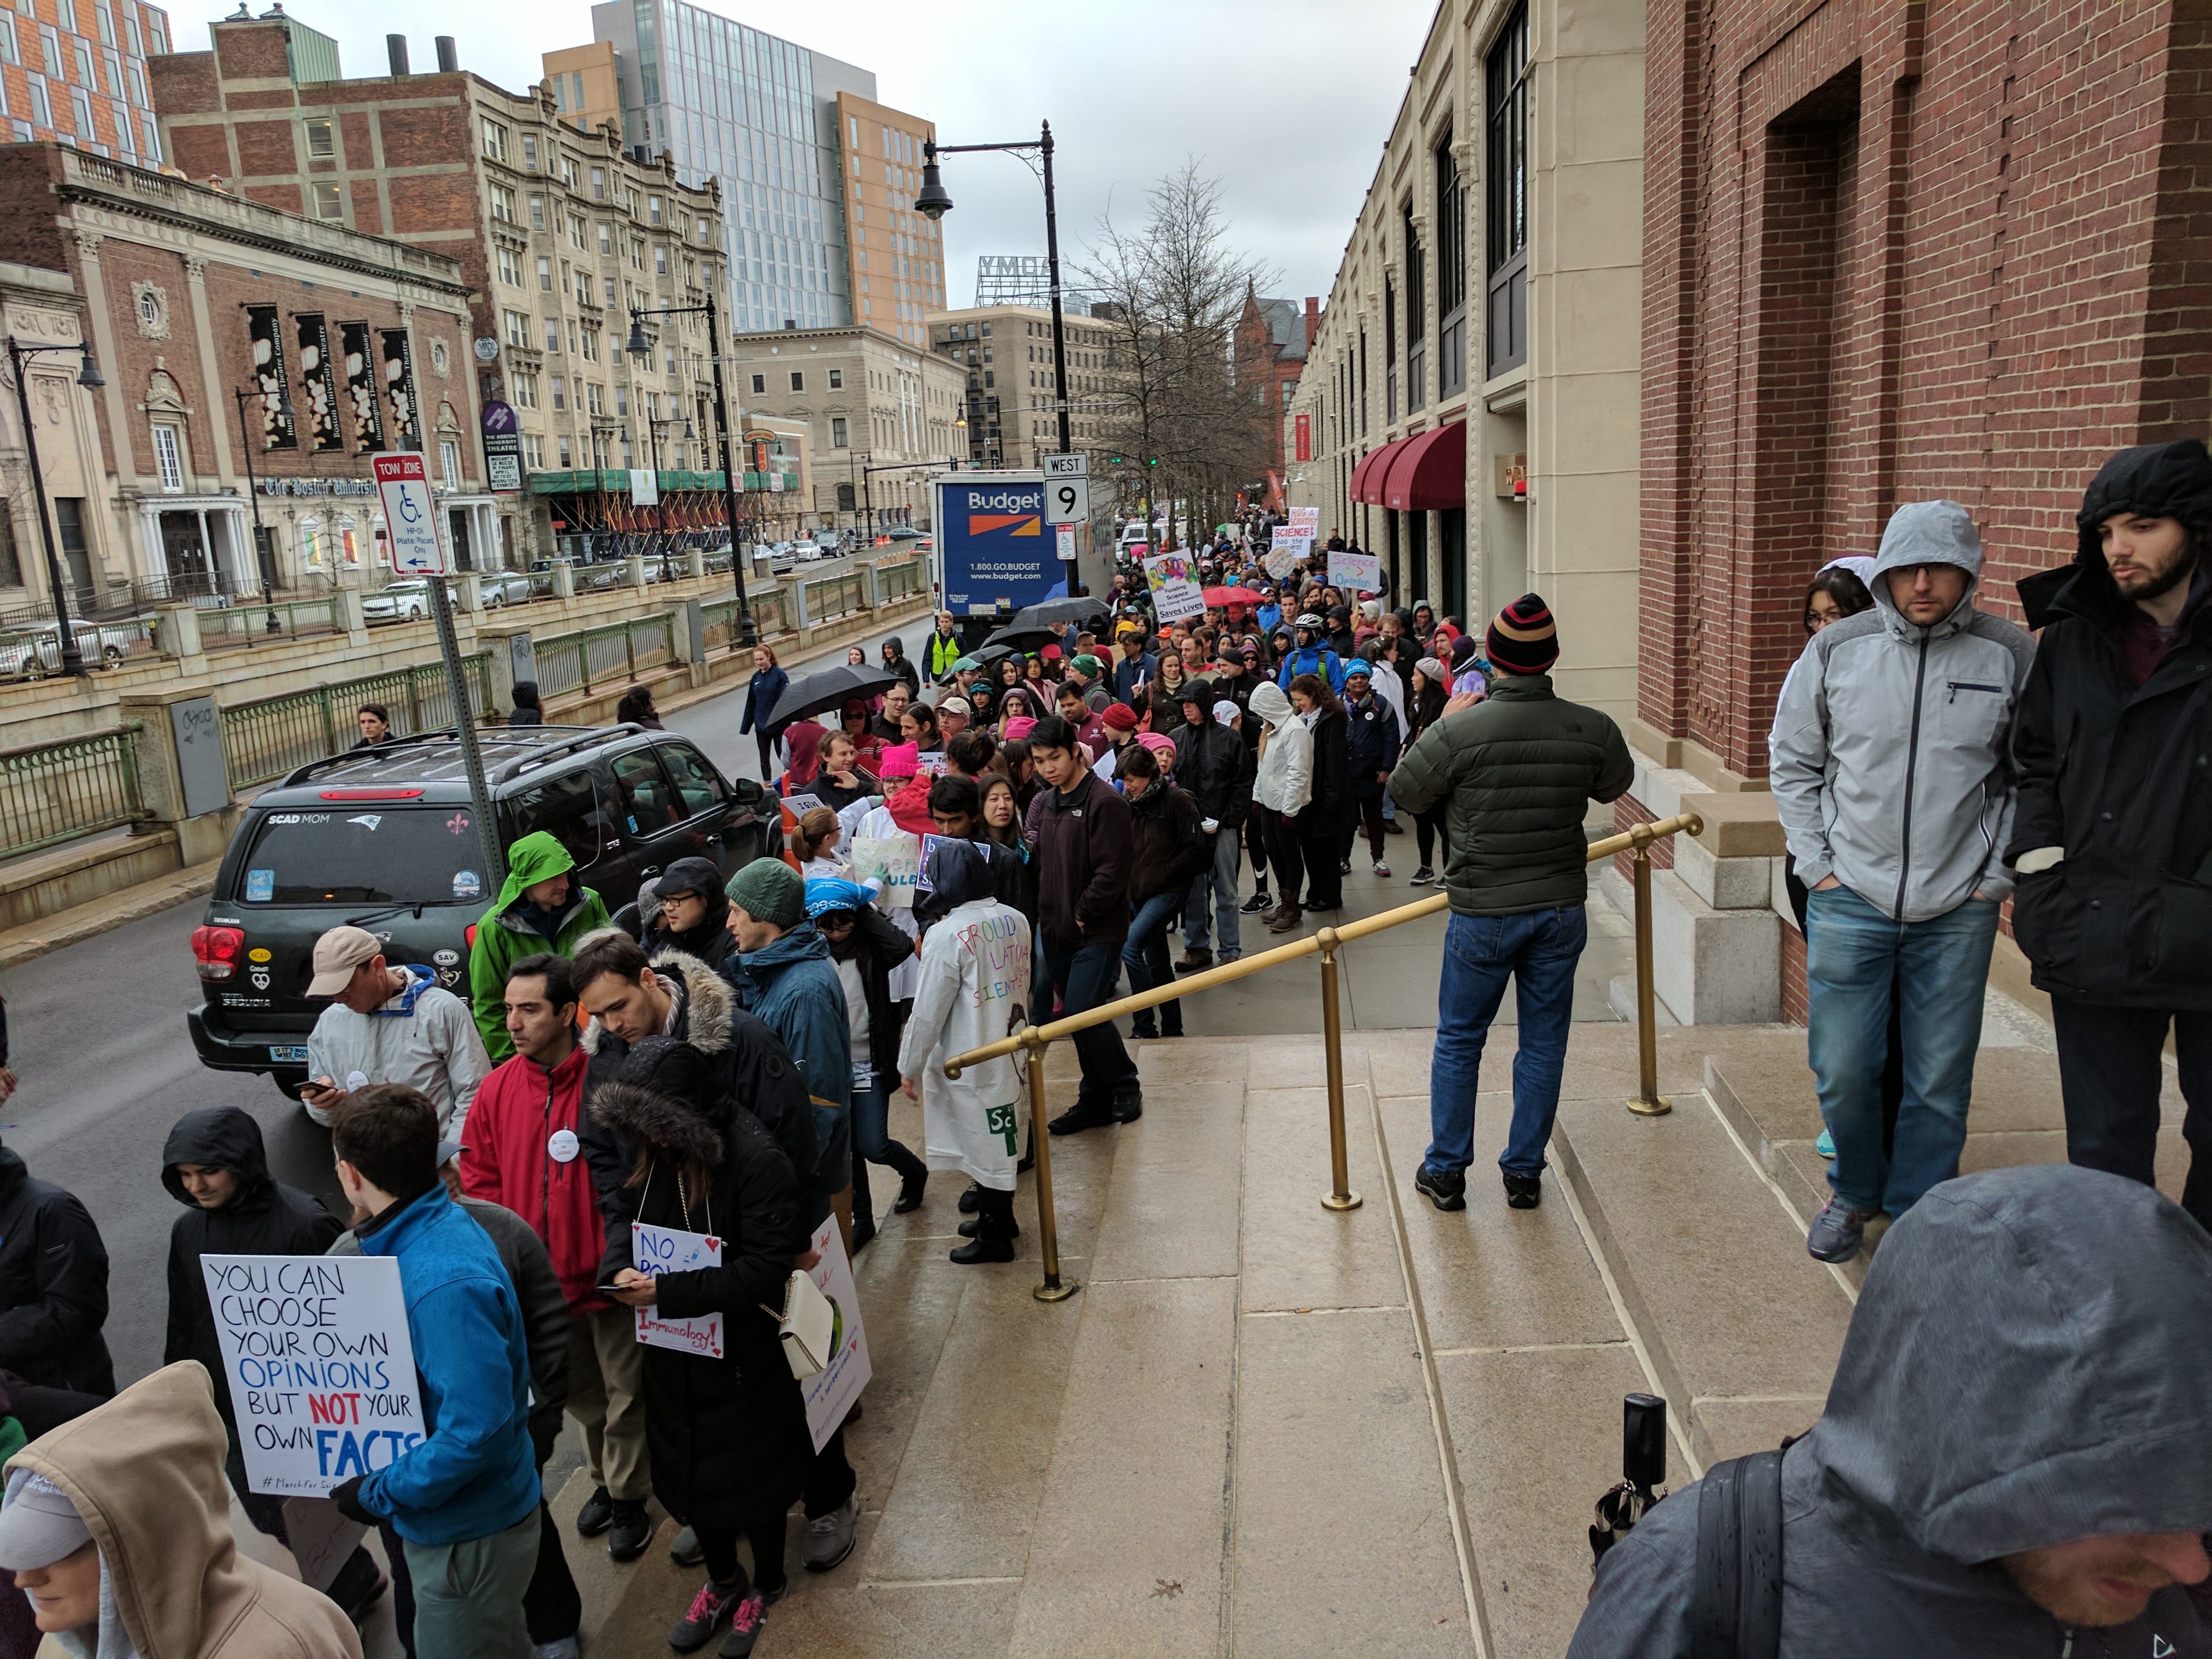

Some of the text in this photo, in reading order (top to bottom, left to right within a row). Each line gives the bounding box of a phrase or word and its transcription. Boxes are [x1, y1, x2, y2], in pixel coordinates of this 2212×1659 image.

[271, 317, 281, 356] Company
[401, 339, 411, 371] Theatre
[319, 325, 341, 438] Boston University Theatre
[362, 333, 383, 441] Huntington Theatre Company
[406, 373, 417, 414] University
[378, 462, 422, 475] TOW ZONE
[1051, 458, 1080, 472] WEST
[265, 477, 286, 496] The
[291, 477, 328, 498] Boston
[968, 492, 1040, 514] Budget
[1058, 486, 1076, 515] 9
[1292, 508, 1306, 517] HUG
[1333, 555, 1376, 567] Science
[970, 573, 1041, 581] www.budget.com
[1165, 585, 1186, 593] Funding
[1335, 573, 1371, 588] Opinion
[1166, 591, 1189, 601] Science
[1160, 602, 1204, 617] Saves Lives
[268, 814, 330, 824] SCAD MOM
[957, 915, 1016, 956] PROUD
[222, 999, 272, 1007] SEQUOIA
[991, 1109, 1011, 1131] Sc
[641, 1232, 675, 1259] NO
[209, 1264, 345, 1295] YOU CAN
[221, 1295, 337, 1327] CHOOSE
[637, 1308, 716, 1350] Immunology!
[228, 1329, 389, 1357] YOUR OWN
[248, 1391, 413, 1425] BUT NOT YOUR
[255, 1424, 314, 1450] OWN
